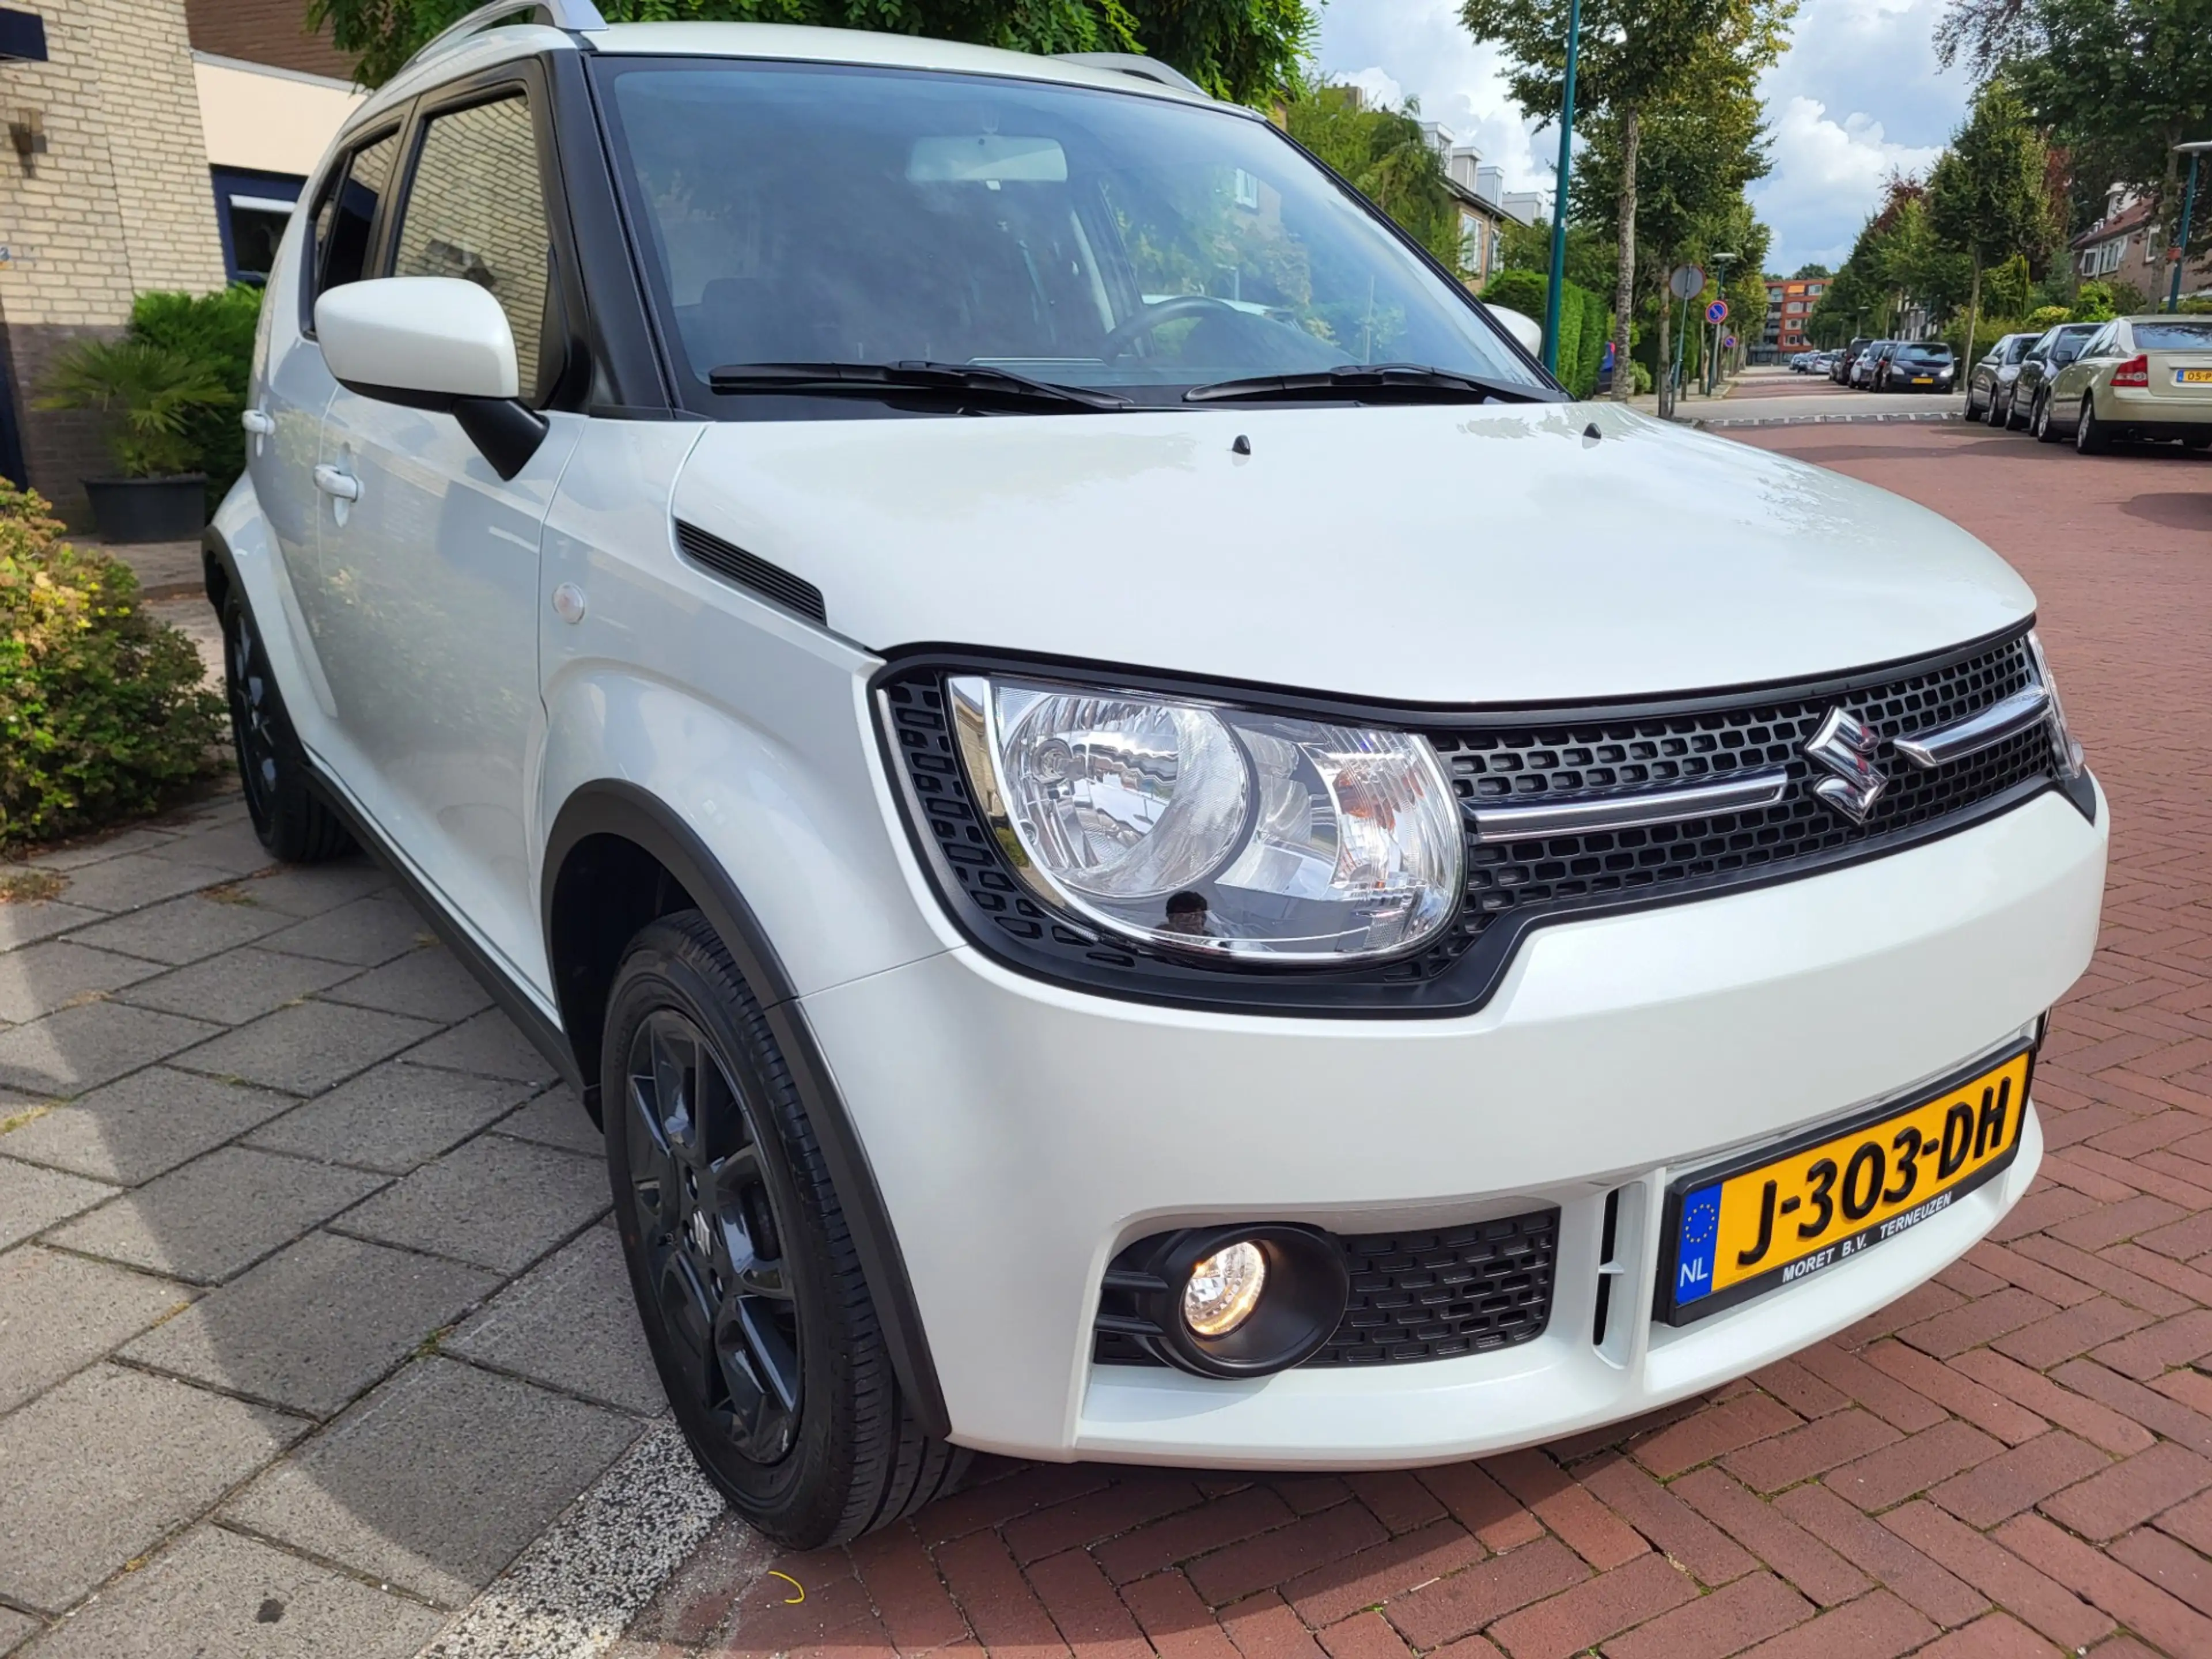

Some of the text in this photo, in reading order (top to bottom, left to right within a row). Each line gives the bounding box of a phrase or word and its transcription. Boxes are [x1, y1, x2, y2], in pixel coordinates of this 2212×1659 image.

[1736, 1076, 2012, 1266] J-303-DH
[1680, 1257, 1709, 1288] NL
[1782, 1191, 1952, 1283] MORET B.V. TERNEUZEN
